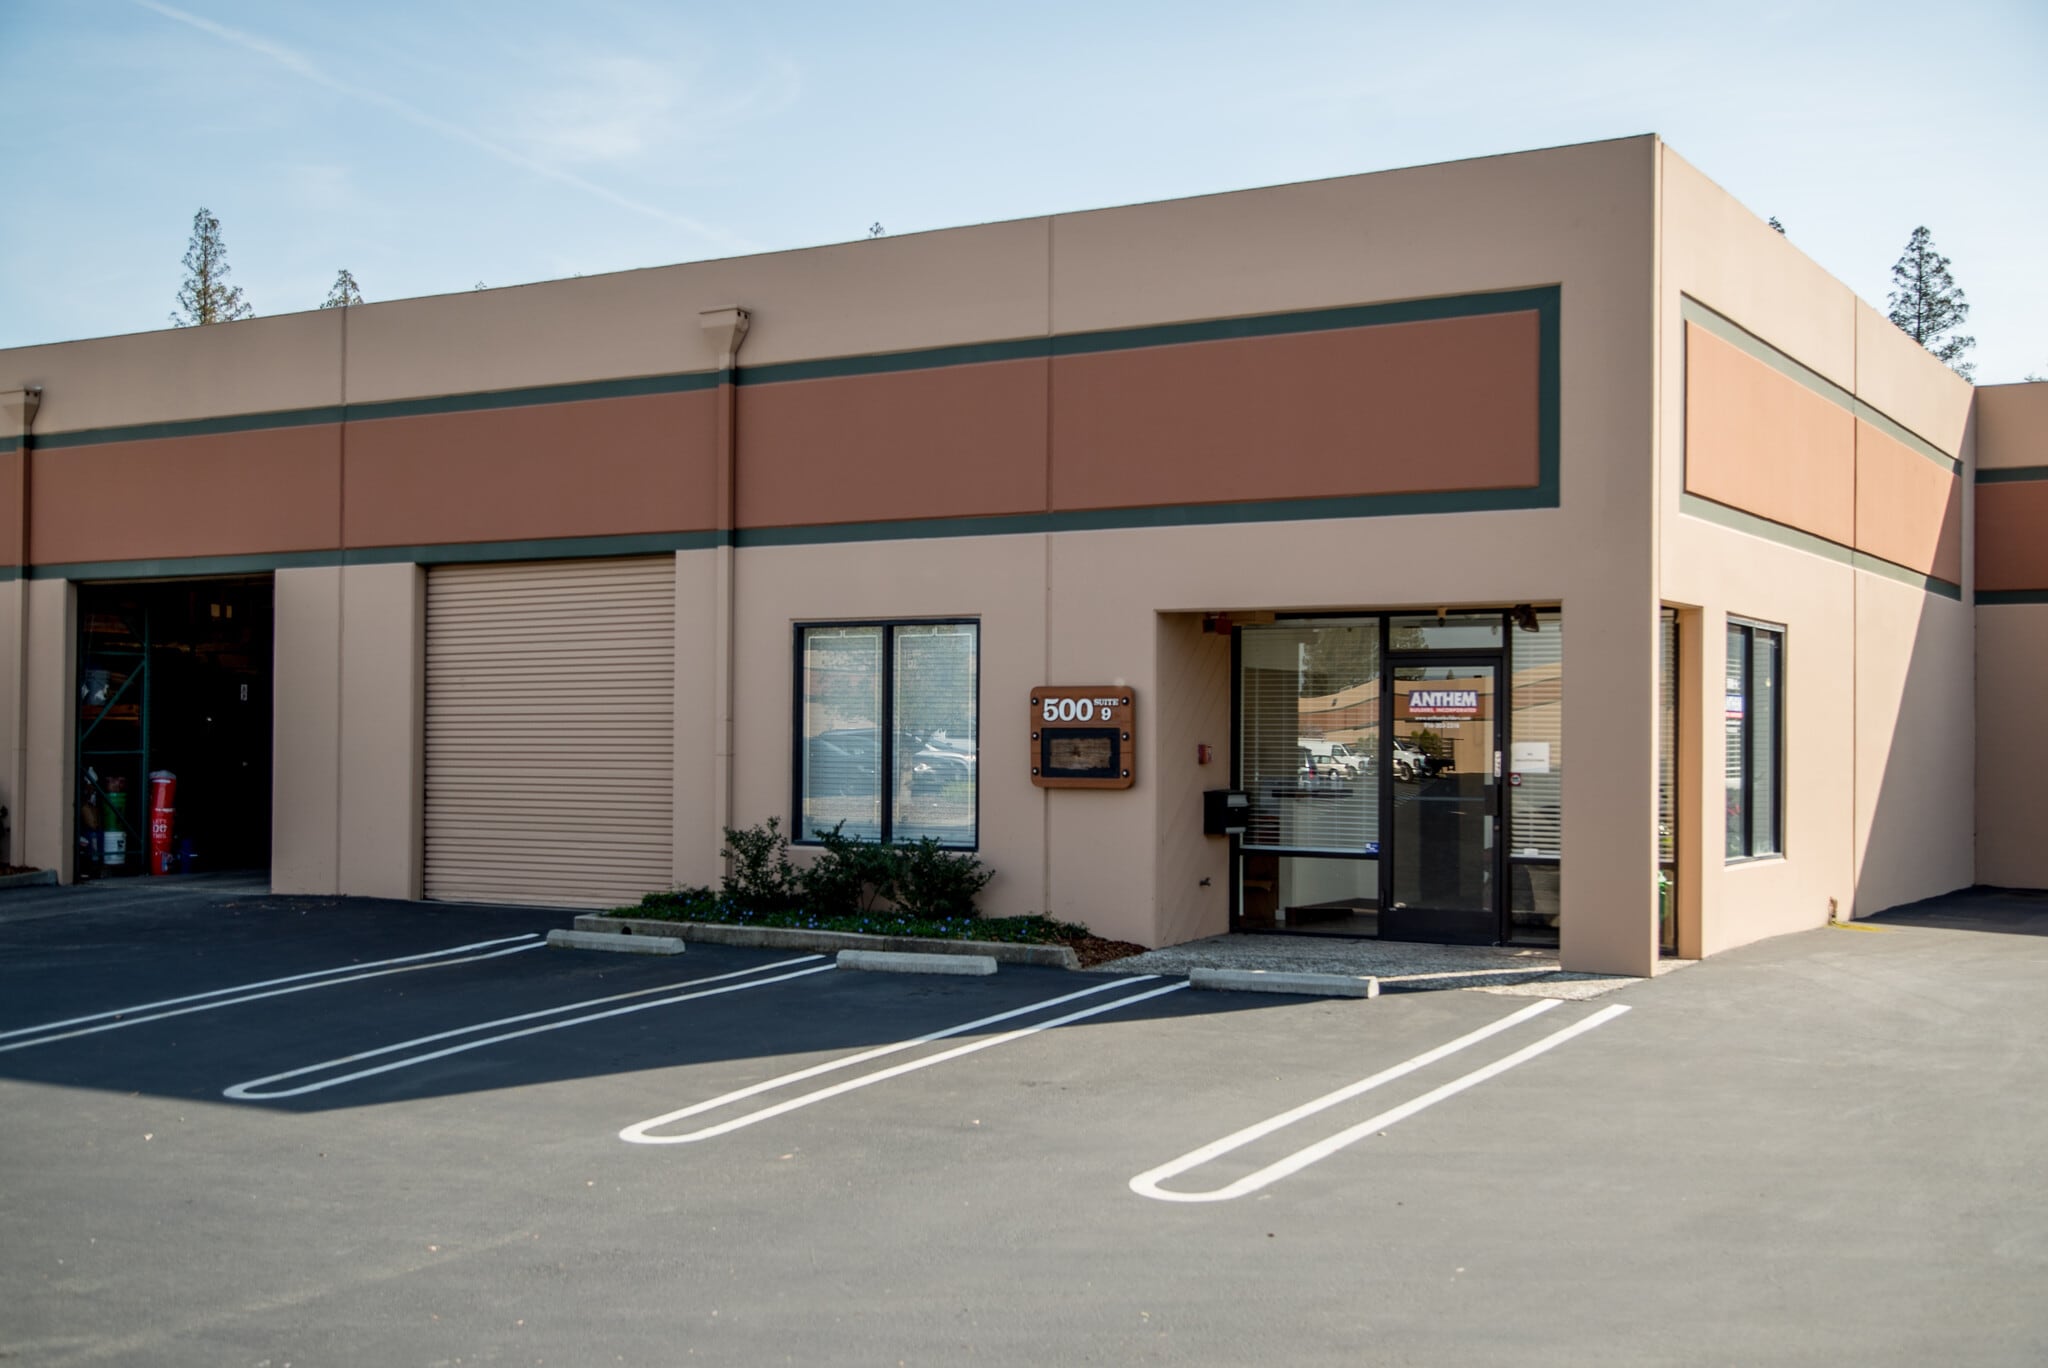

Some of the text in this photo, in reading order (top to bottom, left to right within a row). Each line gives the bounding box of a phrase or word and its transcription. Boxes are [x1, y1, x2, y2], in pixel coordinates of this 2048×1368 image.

[1410, 691, 1477, 706] ANTHEM
[1043, 698, 1119, 721] 500 SUITE
[1101, 707, 1112, 721] 9
[153, 824, 167, 832] DO
